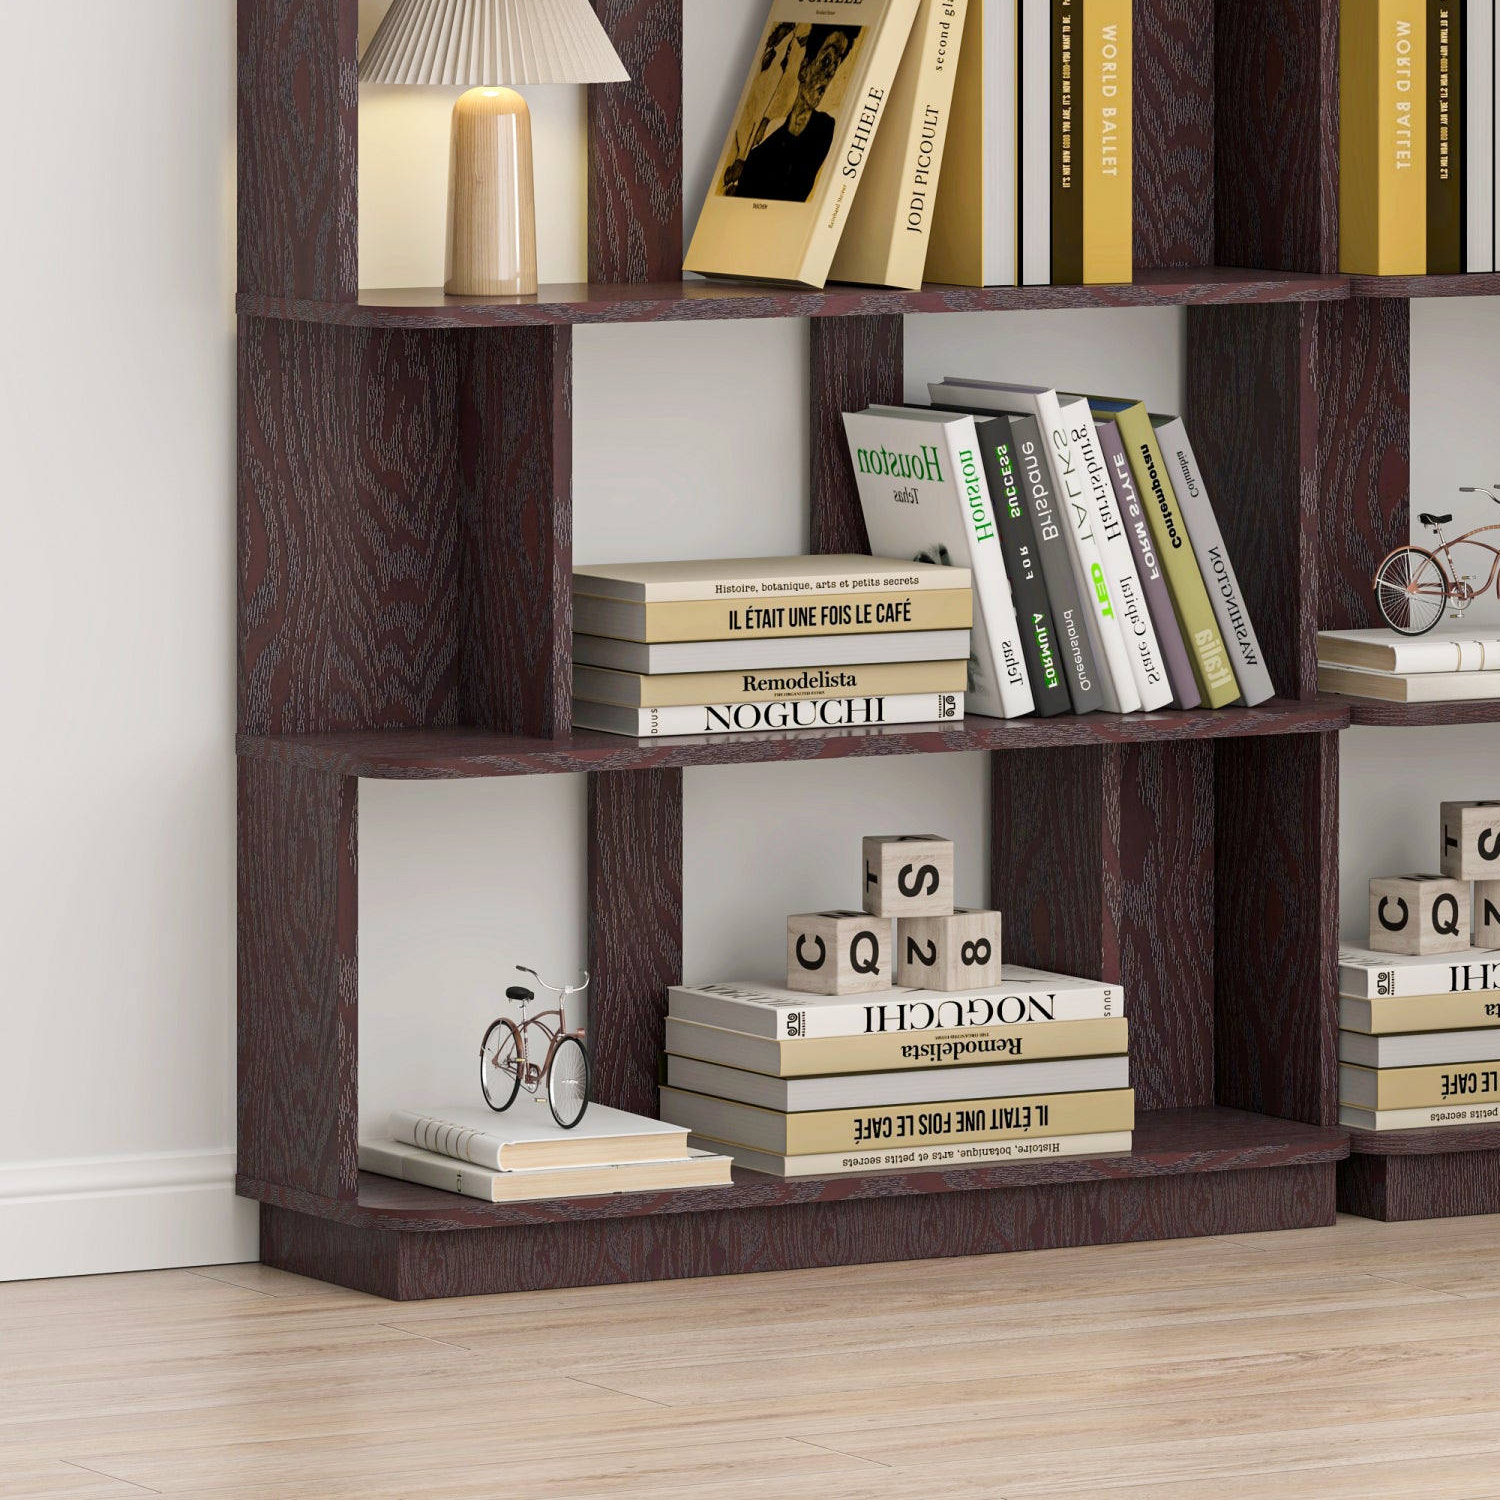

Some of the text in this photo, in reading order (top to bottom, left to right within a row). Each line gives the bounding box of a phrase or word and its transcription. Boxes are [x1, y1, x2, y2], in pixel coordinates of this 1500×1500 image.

[936, 21, 950, 71] second
[1102, 24, 1117, 176] WORLD BALLET
[842, 87, 885, 179] SCHIELE
[906, 104, 939, 234] JODI PICOULT
[715, 576, 919, 594] Histoire, botanique, arts et petits secrets
[729, 598, 912, 630] IL ÉTAIT UNE FOIS LE CAFÉ
[742, 670, 857, 692] Remodelista
[704, 697, 885, 731] NOGUCHI
[897, 862, 941, 898] S
[1431, 893, 1459, 936] Q
[849, 930, 880, 976] Q
[960, 937, 993, 966] 8
[863, 994, 1057, 1034] NOGUCHI
[901, 1036, 1023, 1062] Remodelista
